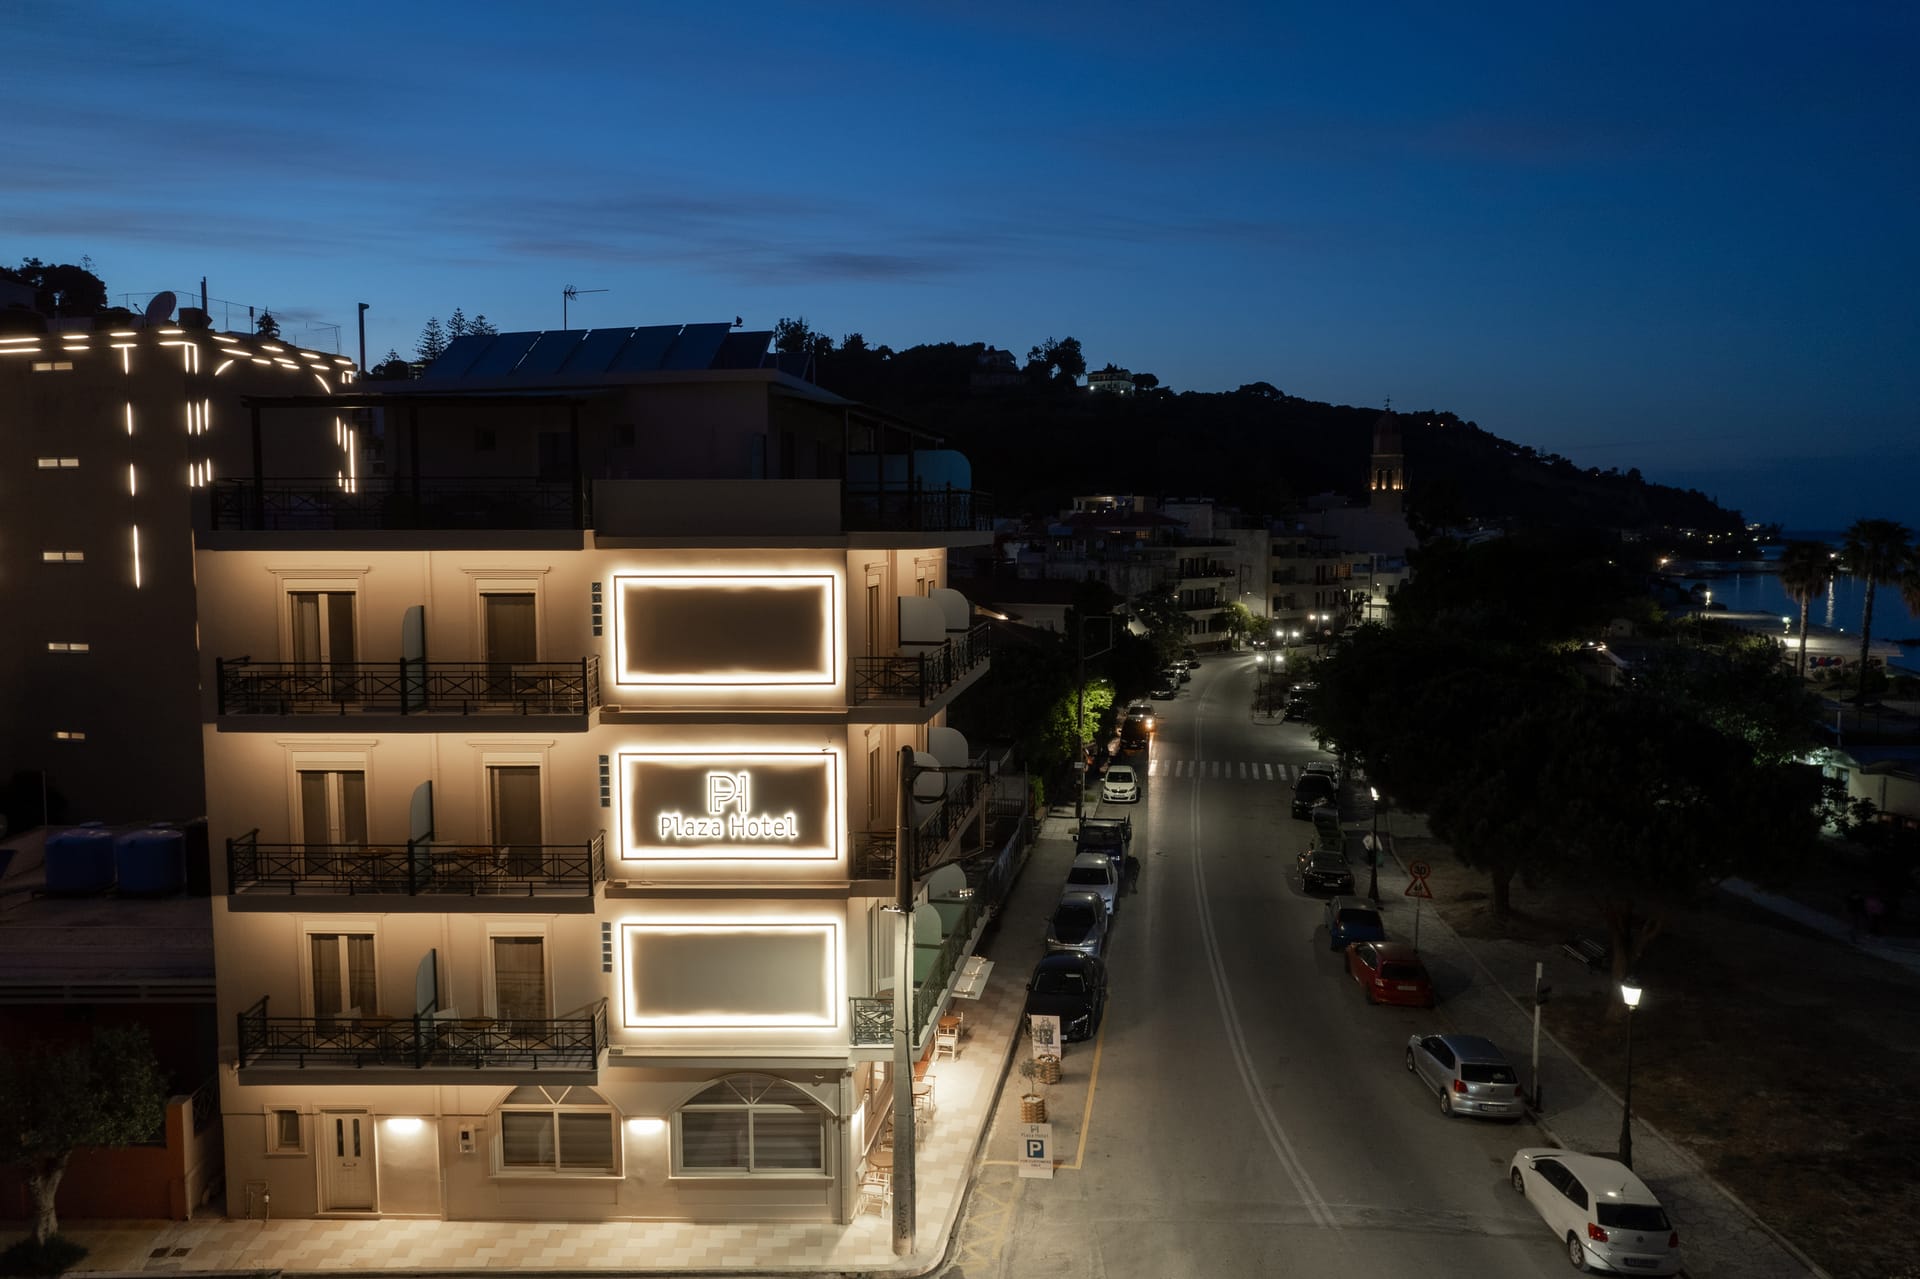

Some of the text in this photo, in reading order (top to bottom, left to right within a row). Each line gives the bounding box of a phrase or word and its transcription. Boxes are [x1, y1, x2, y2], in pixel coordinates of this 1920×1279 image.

[659, 815, 798, 837] Plaza Hotel
[1029, 1141, 1042, 1157] P
